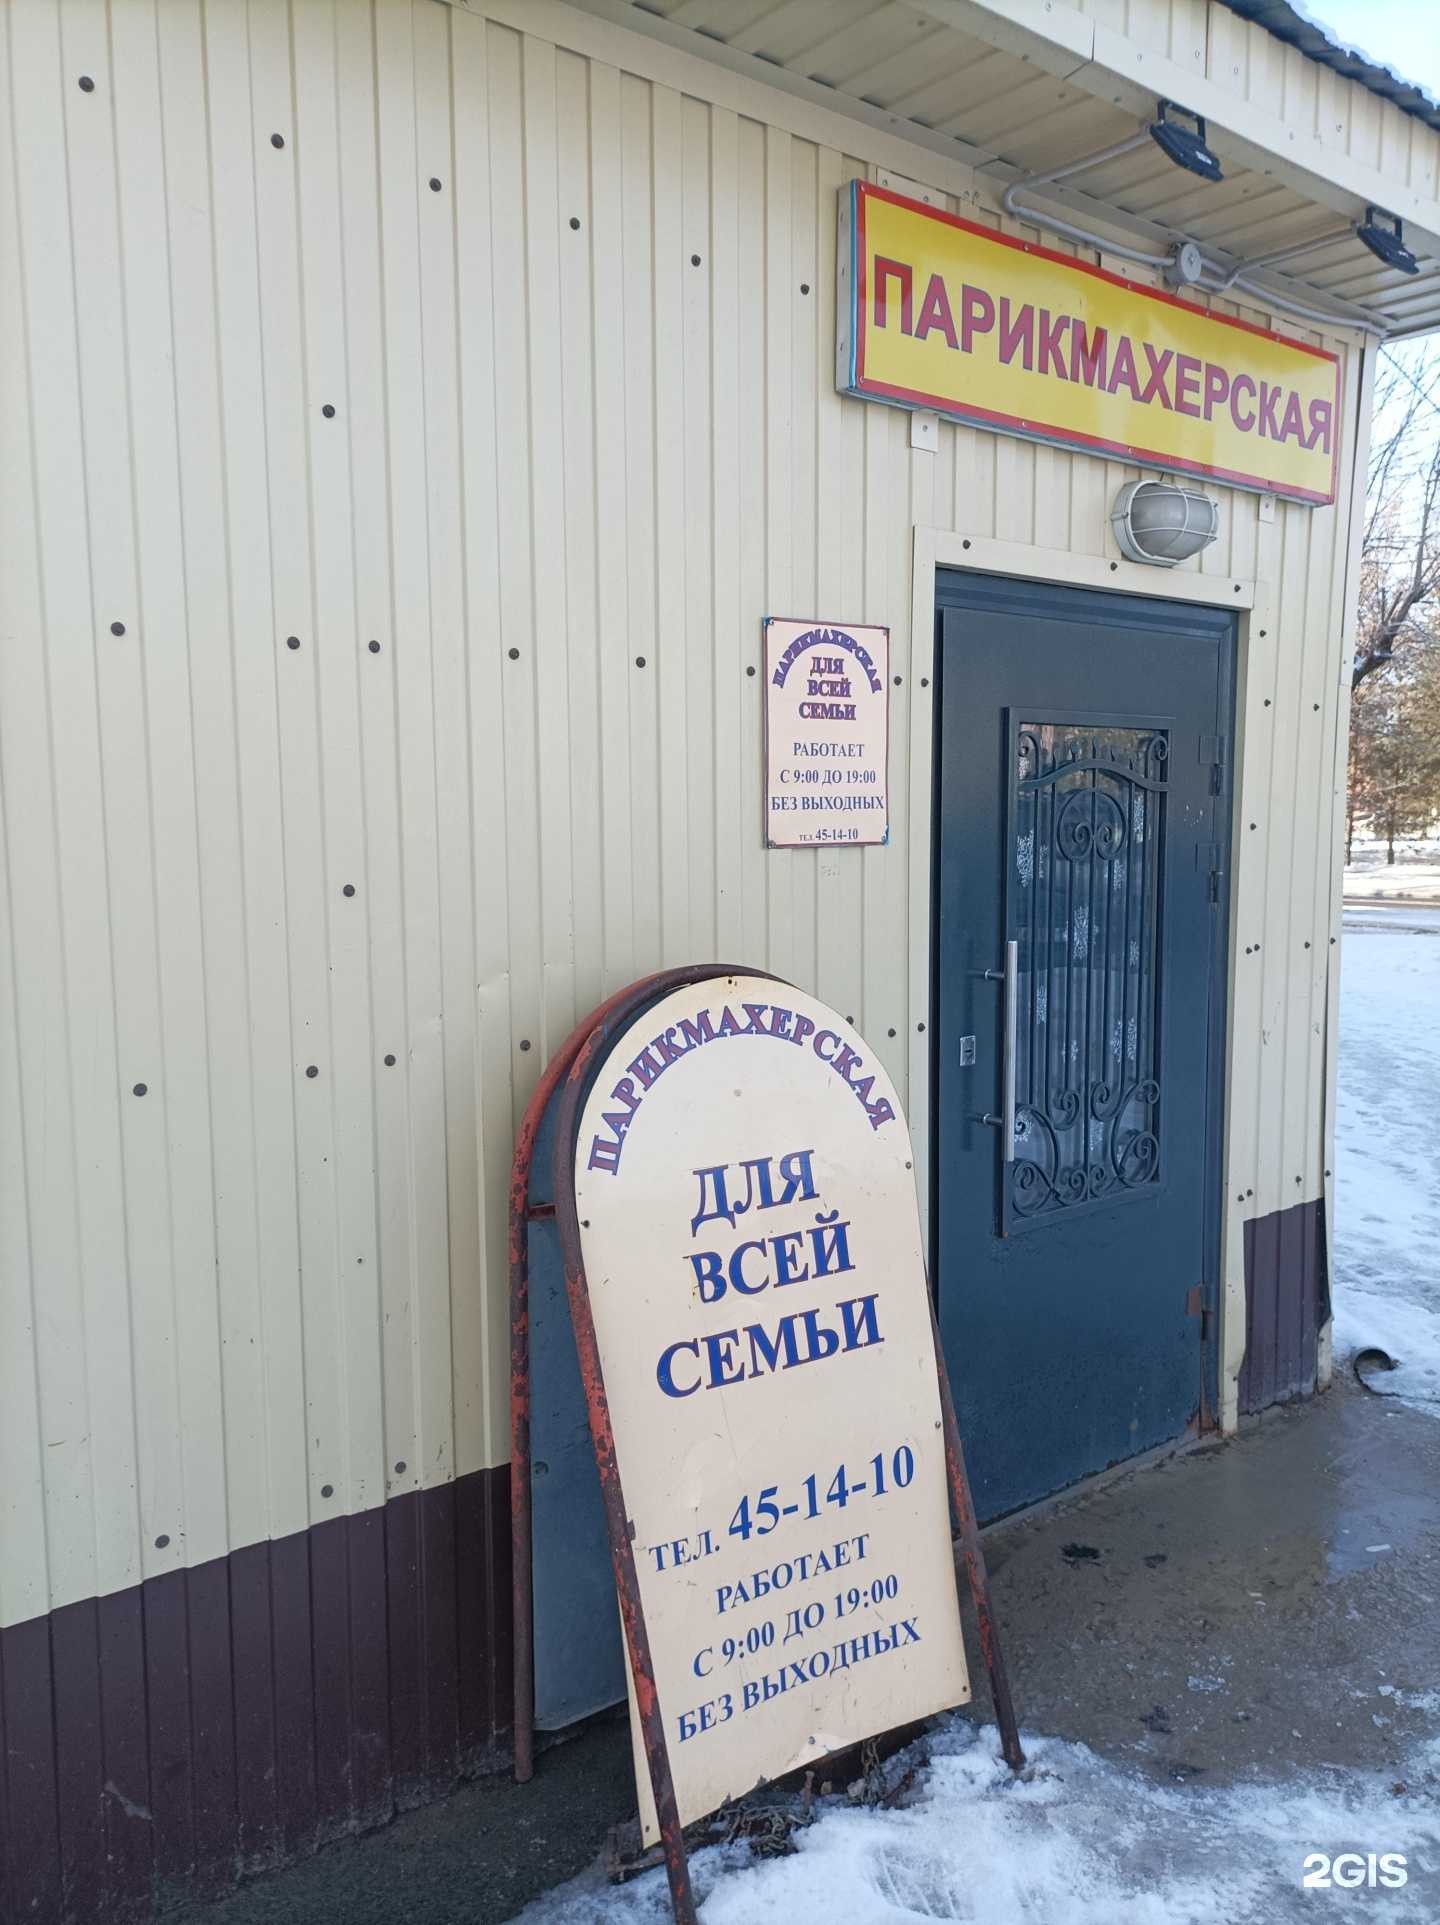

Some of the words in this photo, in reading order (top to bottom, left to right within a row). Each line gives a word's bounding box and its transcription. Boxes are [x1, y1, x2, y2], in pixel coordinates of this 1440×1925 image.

[874, 254, 1332, 454] ПАРИКМАХЕРСКАЯ
[772, 628, 882, 694] ПАРИКМАХЕРСКАЯ
[807, 677, 852, 698] ВСЕЙ
[810, 656, 844, 677] ДЛЯ
[793, 742, 865, 758] РАБОТАЕТ
[798, 702, 857, 721] СЕМЬИ
[771, 796, 798, 811] БЕЗ
[801, 795, 884, 812] ВЫХОДНЫХ
[780, 769, 790, 784] С
[793, 769, 819, 784] 9:00
[822, 769, 842, 786] ДО
[846, 769, 876, 784] 19:00
[815, 828, 859, 841] 45-14-10
[588, 1003, 896, 1176] ПАРИКМАХЕРСКАЯ
[690, 1149, 820, 1237] ДЛЯ
[683, 1209, 856, 1304] ВСЕЙ
[656, 1293, 885, 1398] СЕМЬИ
[648, 1529, 720, 1573] ТЕЛ.
[728, 1445, 914, 1541] 45-14-10
[715, 1533, 870, 1615] РАБОТАЕТ
[693, 1647, 714, 1678] С
[721, 1621, 775, 1667] 9:00
[783, 1602, 825, 1645] ДО
[835, 1574, 898, 1620] 19:00
[676, 1694, 734, 1743] БЕЗ
[742, 1617, 922, 1712] ВЫХОДНЫХ
